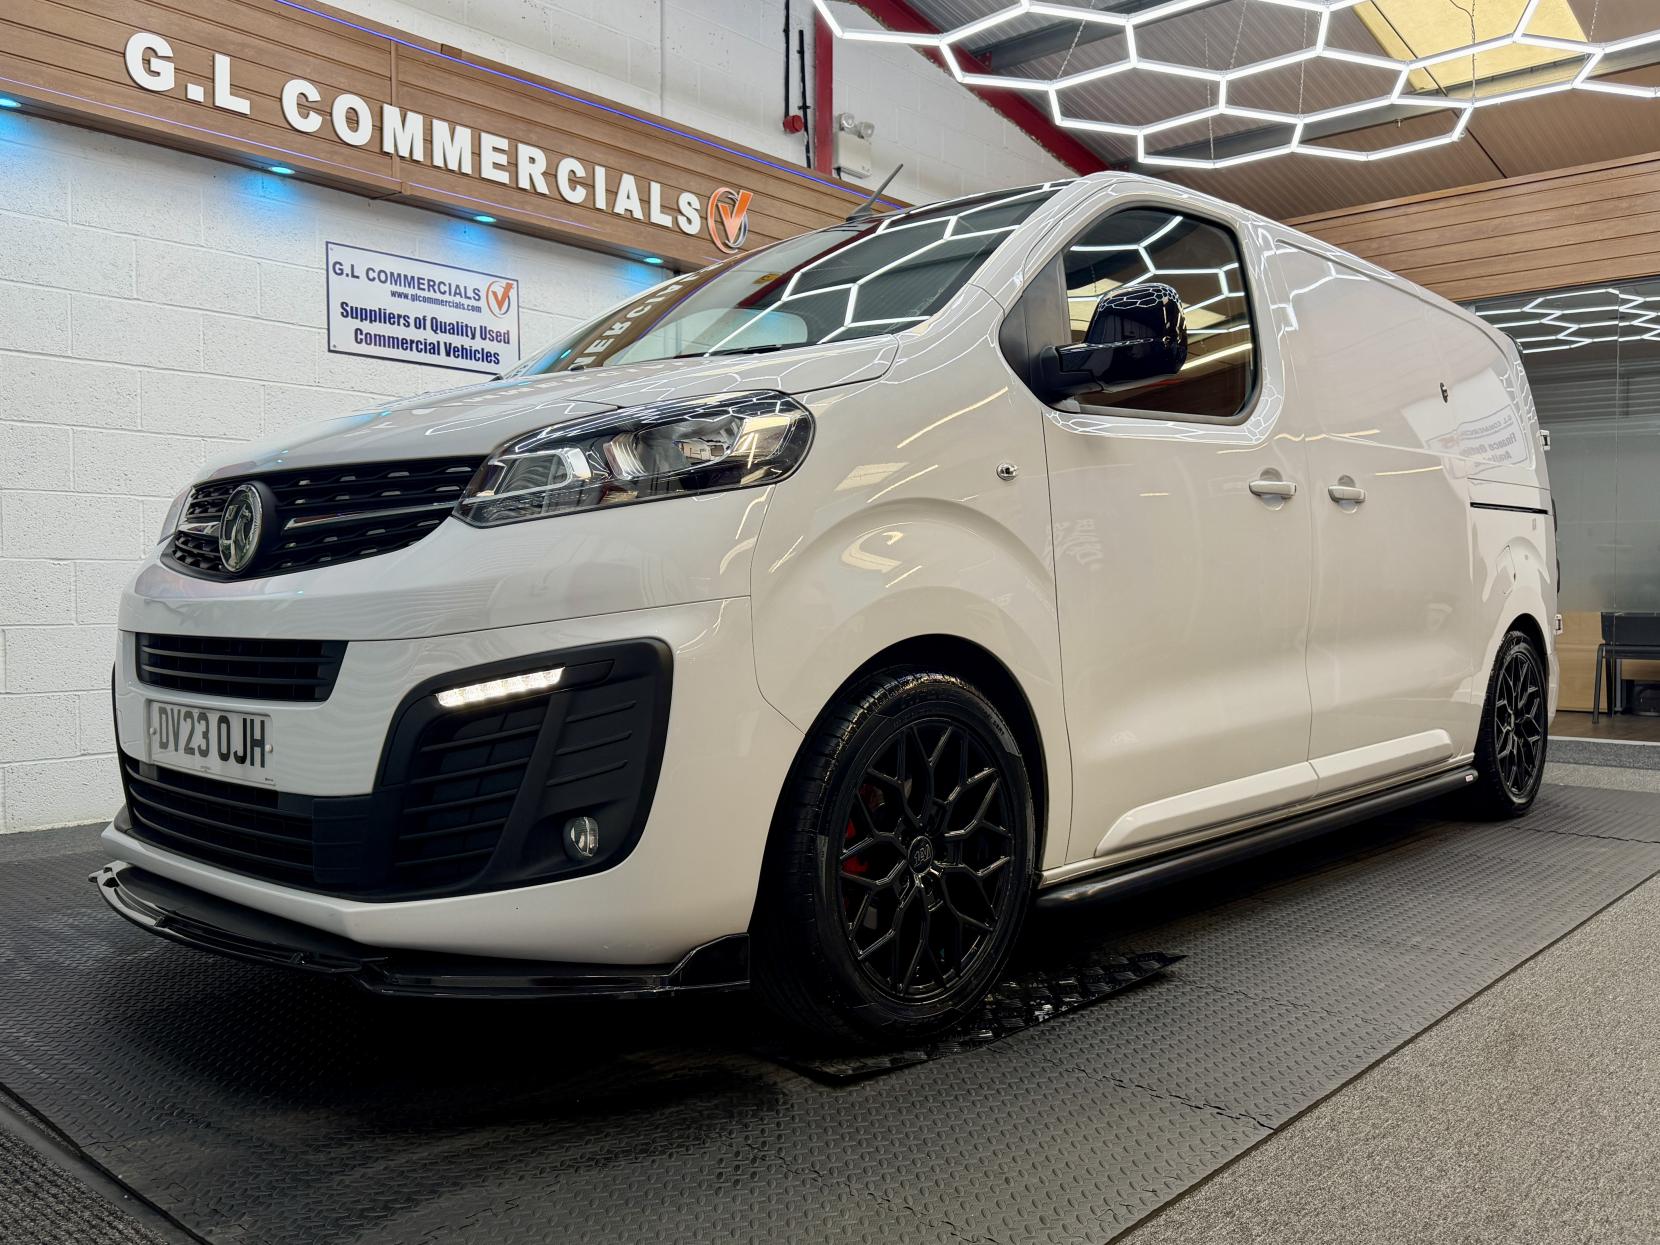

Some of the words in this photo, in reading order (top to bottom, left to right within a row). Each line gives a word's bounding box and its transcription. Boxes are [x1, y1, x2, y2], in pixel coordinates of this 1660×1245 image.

[125, 32, 251, 115] G.L
[281, 79, 701, 235] COMMERCIALS
[332, 261, 360, 280] G.L
[365, 267, 482, 302] COMMERCIALS
[390, 290, 482, 313] www.glcommercials.com
[340, 301, 410, 329] Suppliers
[414, 314, 427, 331] of
[430, 317, 477, 340] Quality
[479, 325, 511, 345] Used
[354, 328, 441, 357] Commercial
[443, 341, 501, 365] Vehicles
[158, 706, 210, 758] DV23
[217, 715, 265, 768] OJH
